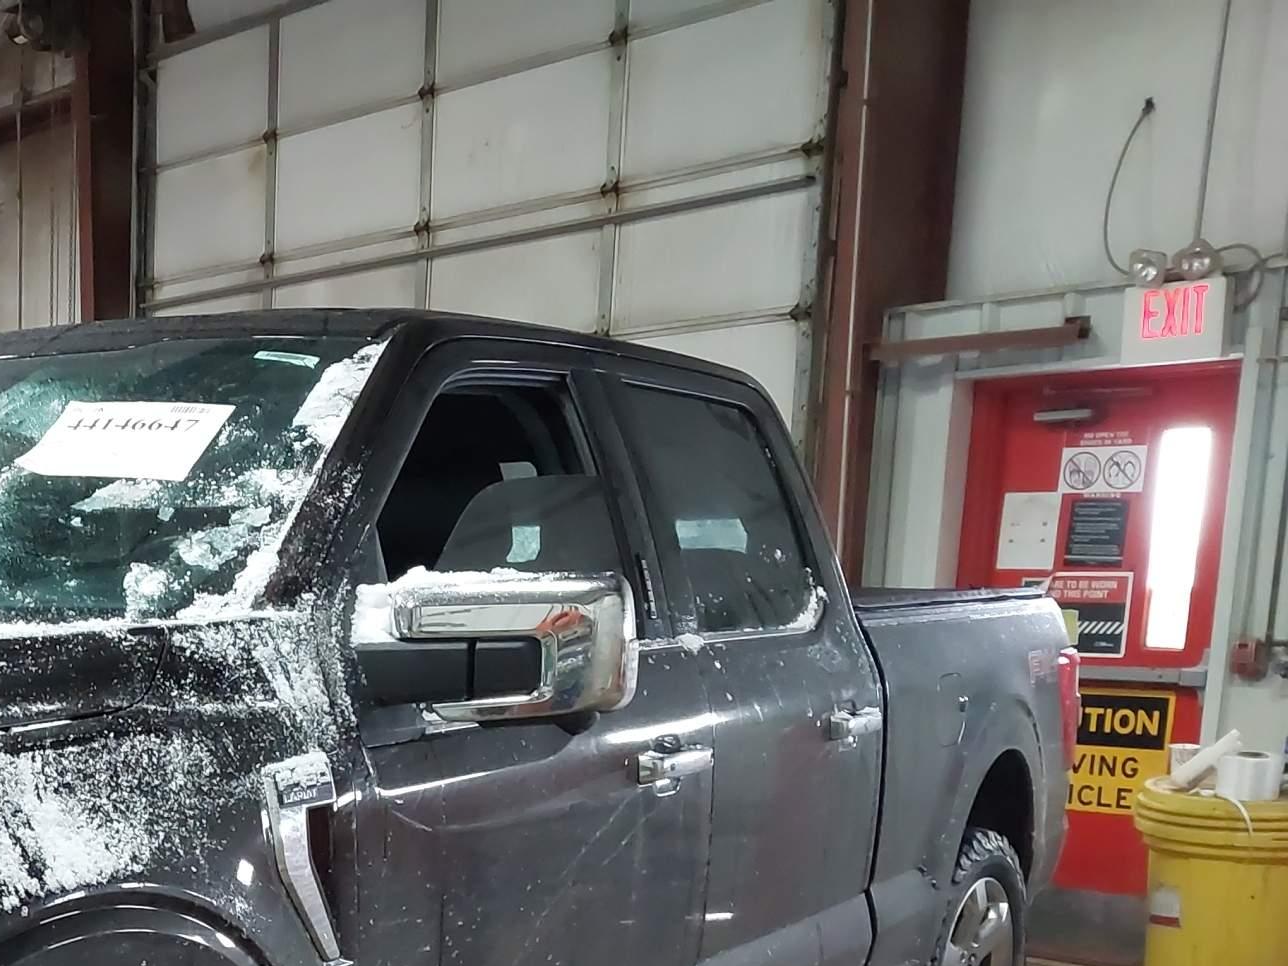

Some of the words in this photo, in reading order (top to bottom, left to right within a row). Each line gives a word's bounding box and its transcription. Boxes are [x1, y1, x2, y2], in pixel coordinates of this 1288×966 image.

[1142, 285, 1209, 338] EXIT
[67, 417, 201, 432] 44146647
[1078, 706, 1160, 736] TION
[1072, 753, 1139, 779] VING
[1067, 783, 1133, 809] ICLE
